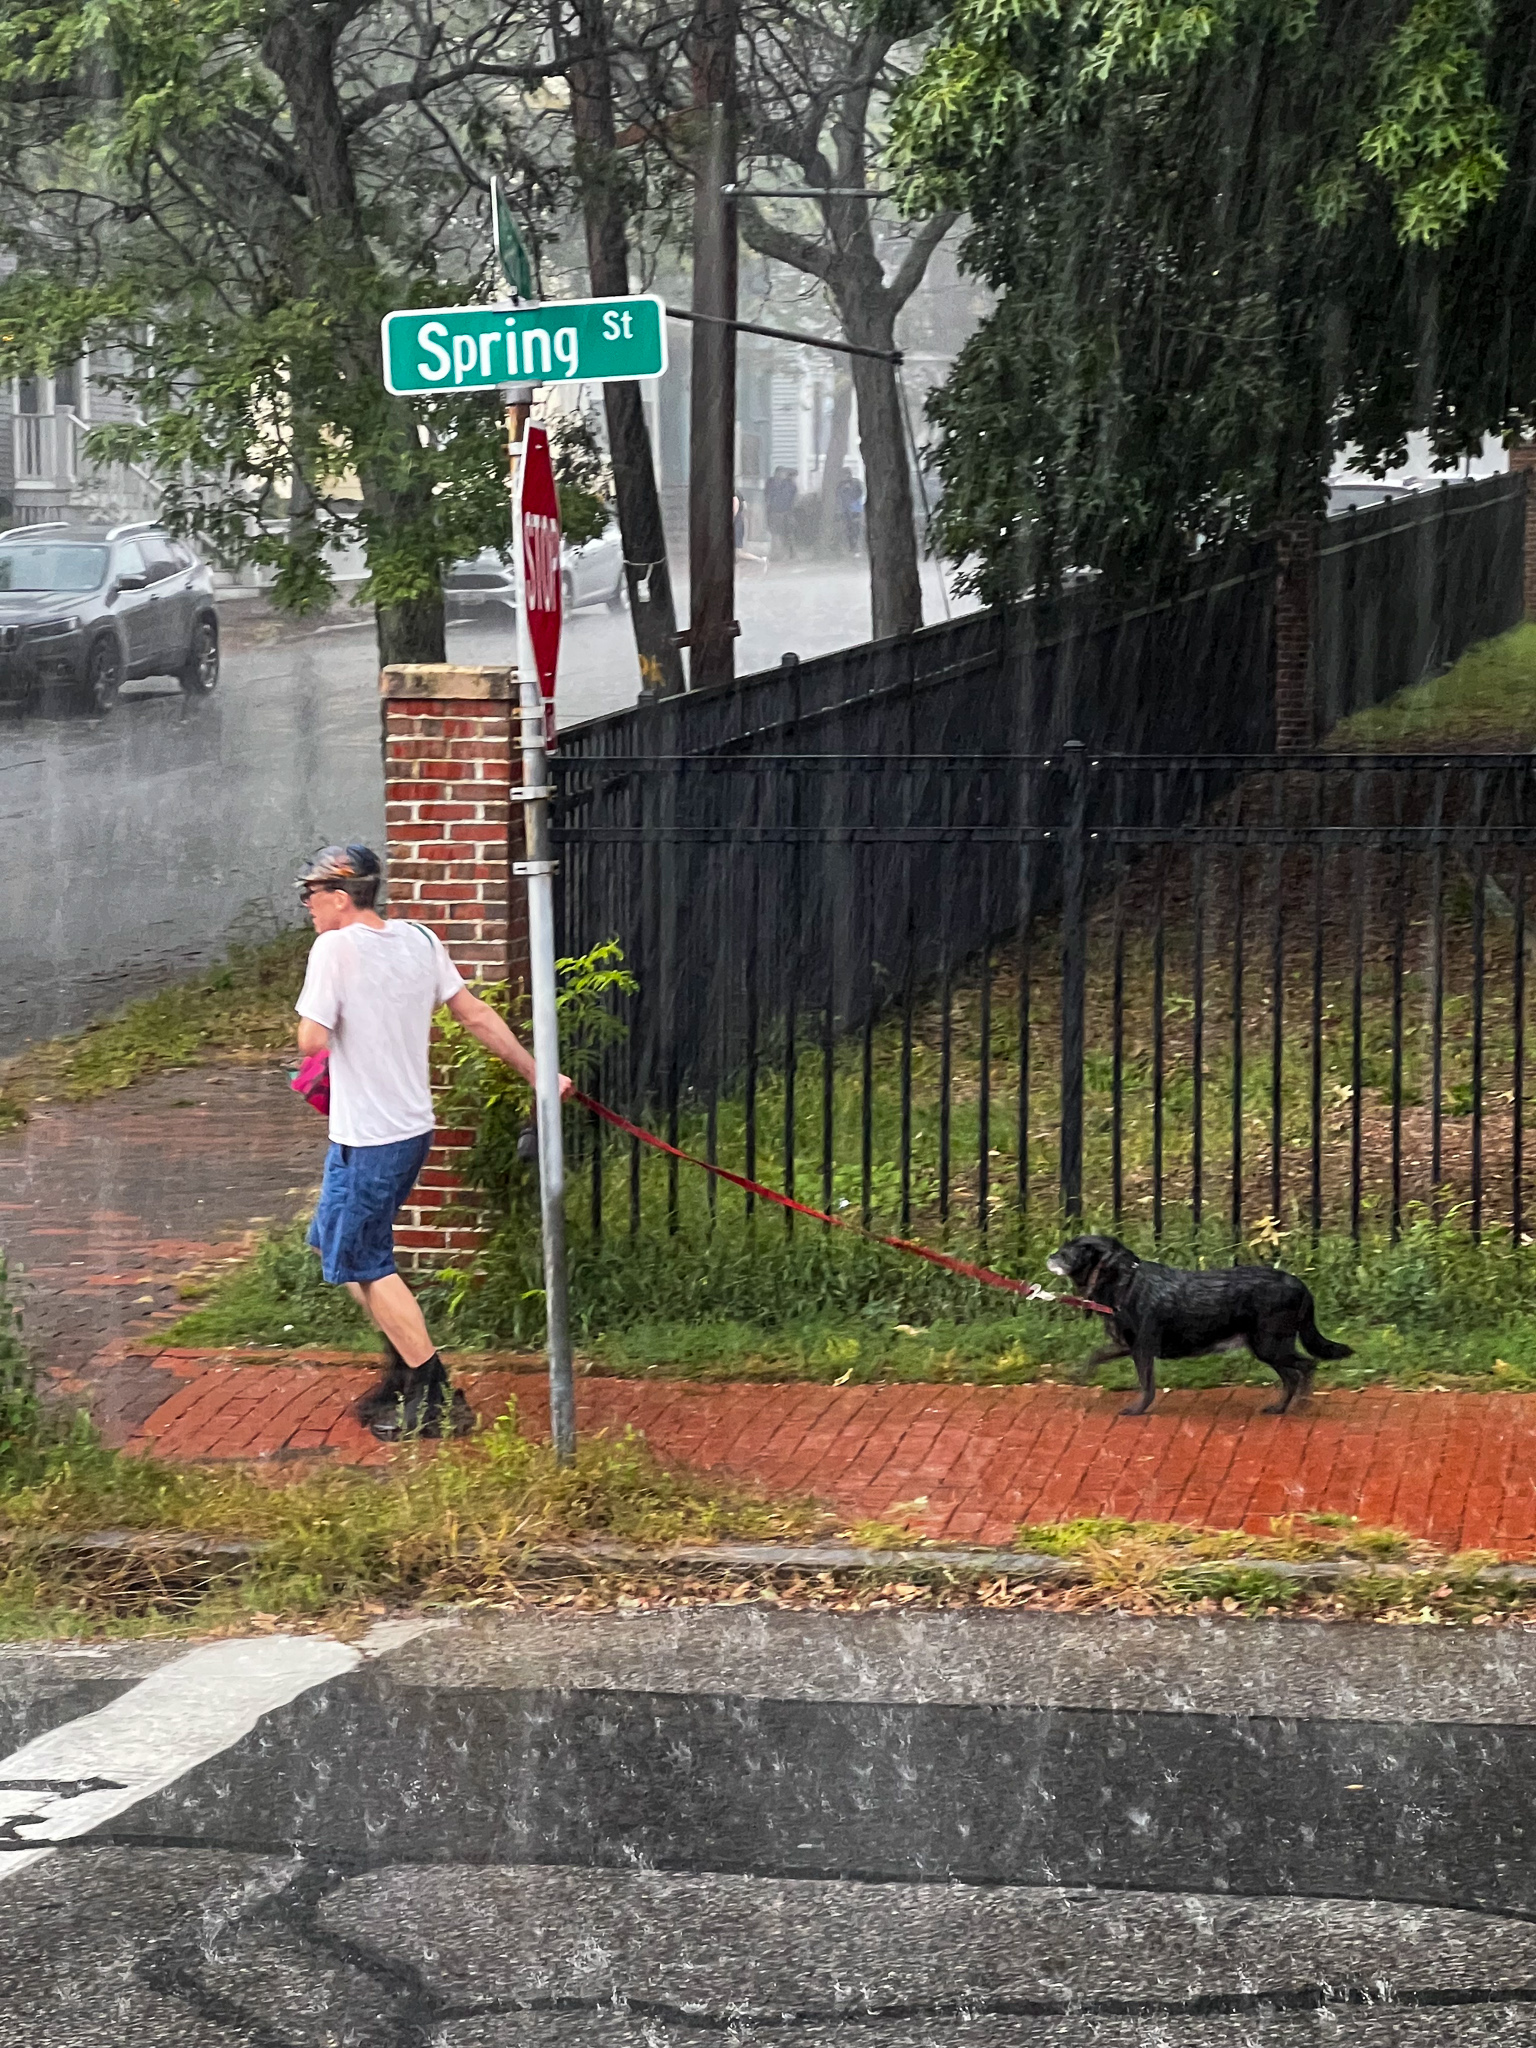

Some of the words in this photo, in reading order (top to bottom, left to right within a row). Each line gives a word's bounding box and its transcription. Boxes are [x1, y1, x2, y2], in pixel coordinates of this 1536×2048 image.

[417, 318, 579, 384] Spring
[603, 310, 633, 341] St
[524, 511, 559, 612] STOP
